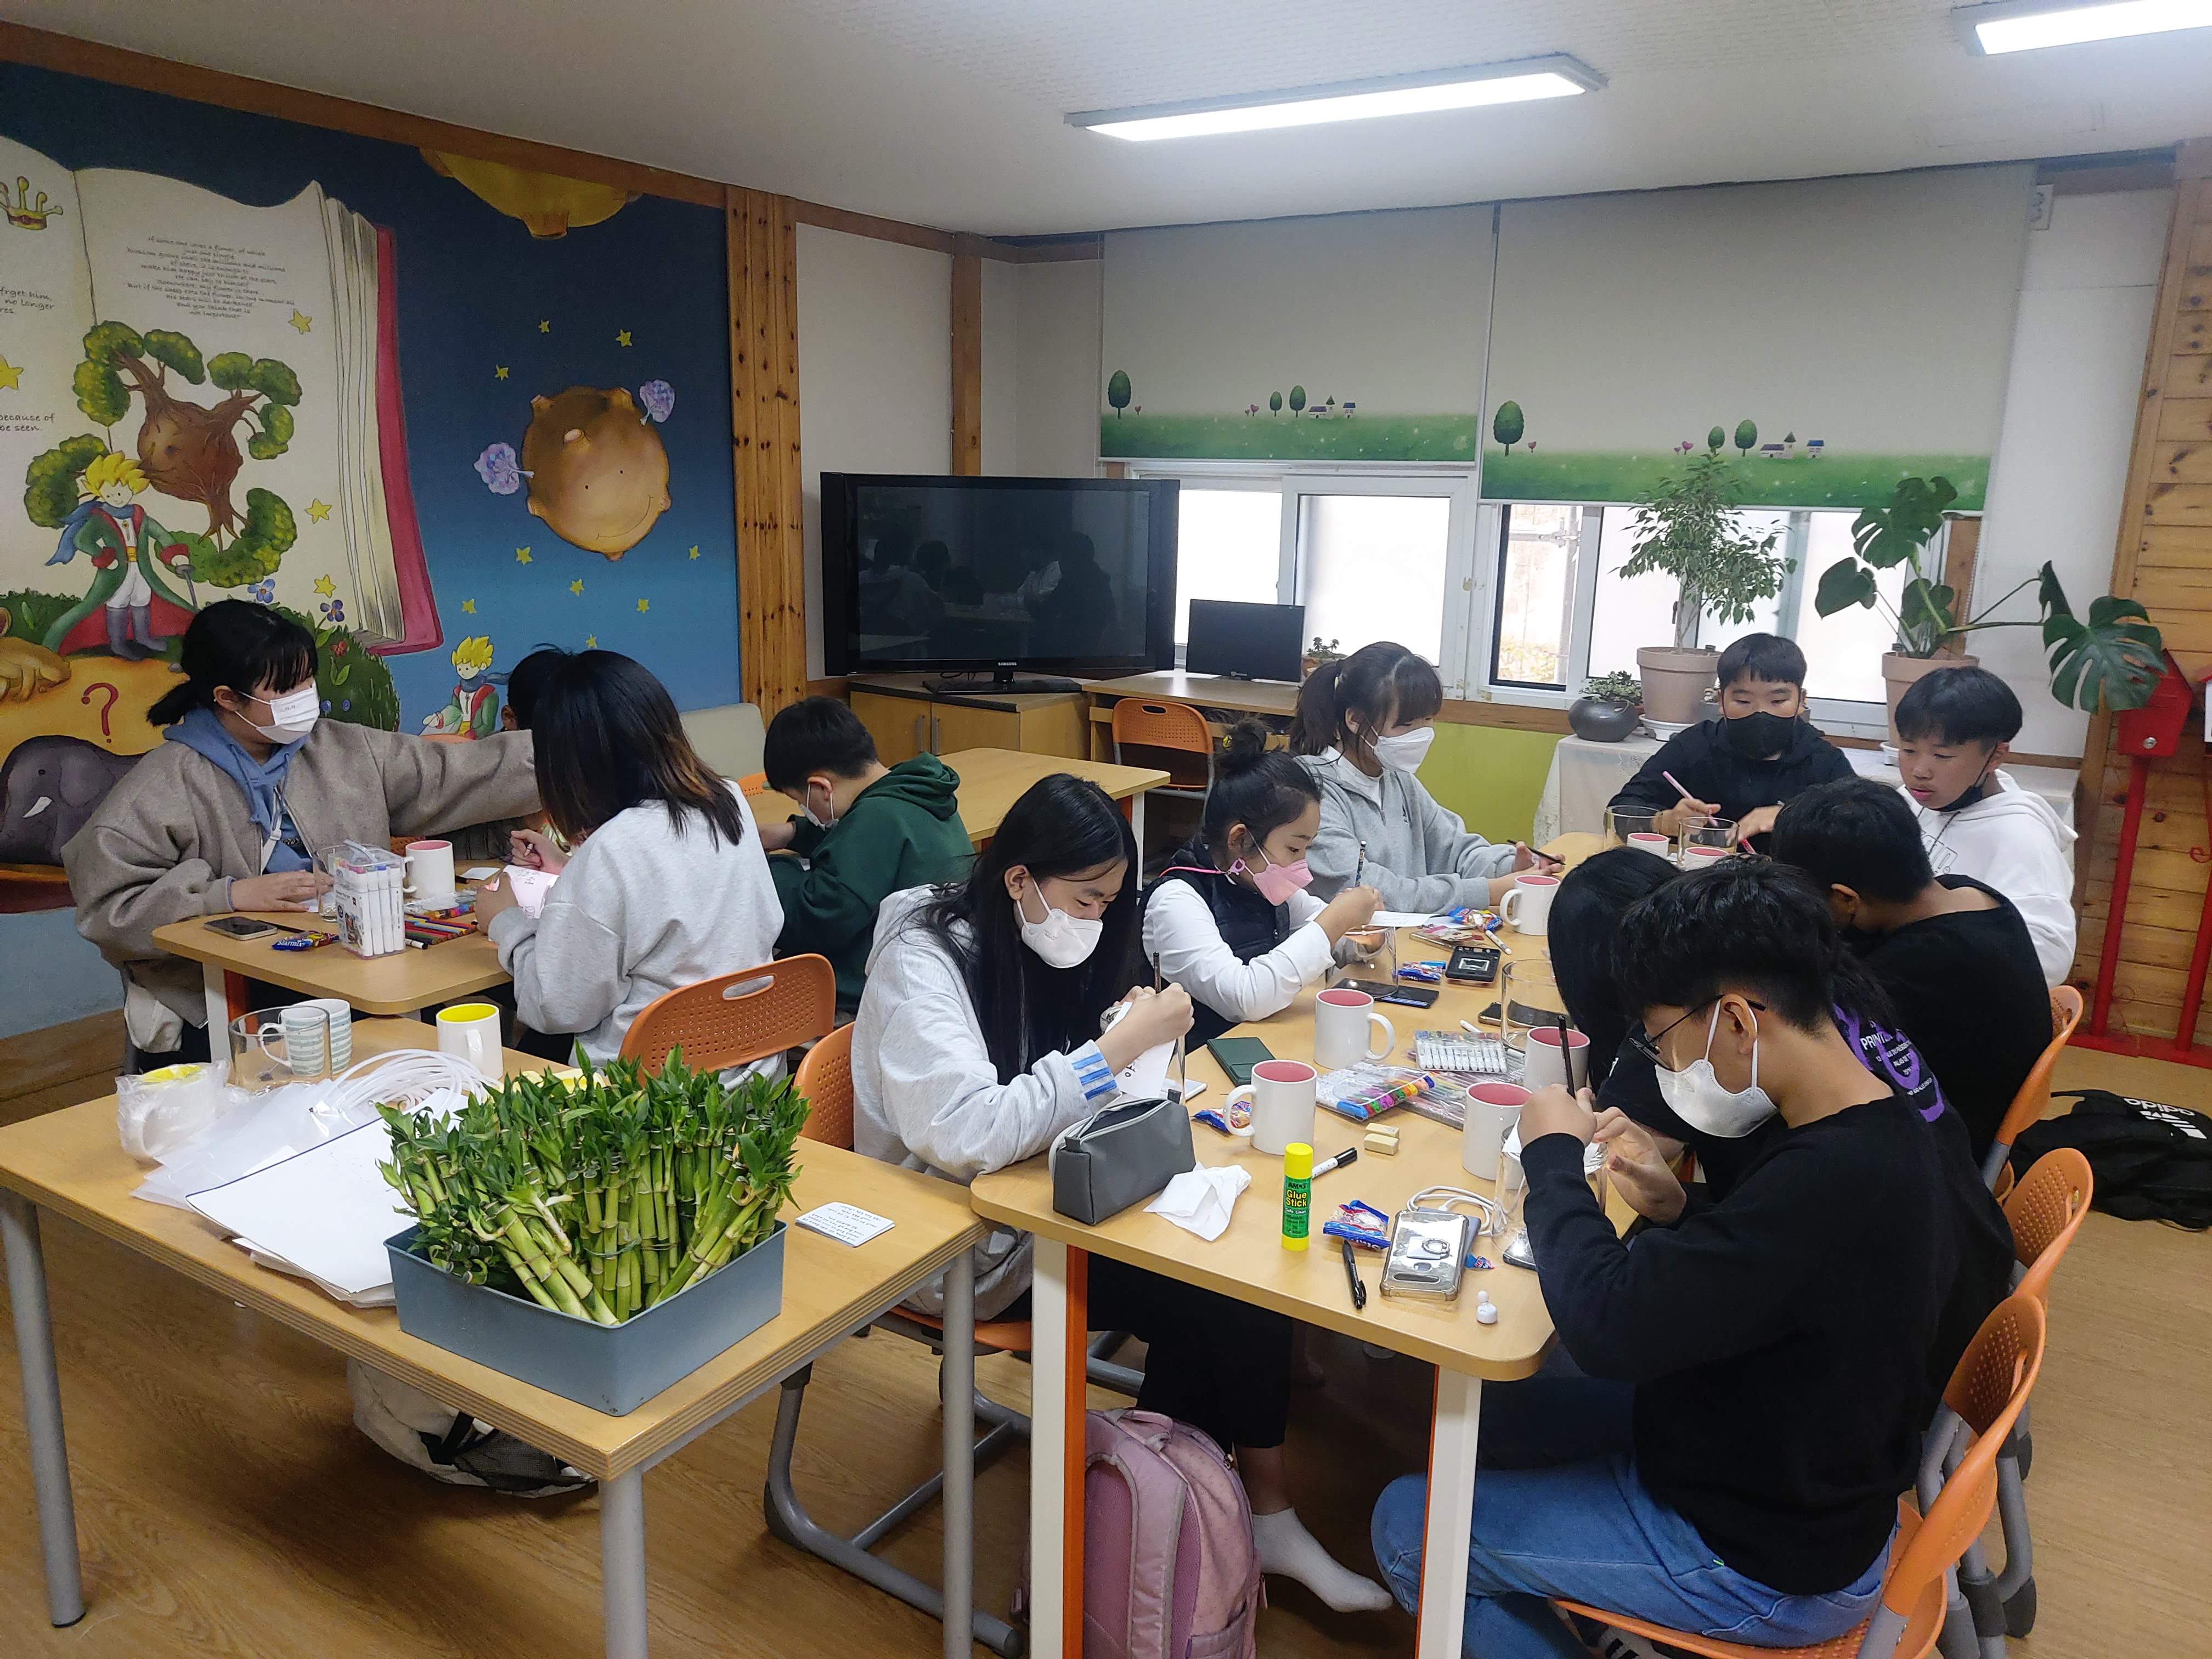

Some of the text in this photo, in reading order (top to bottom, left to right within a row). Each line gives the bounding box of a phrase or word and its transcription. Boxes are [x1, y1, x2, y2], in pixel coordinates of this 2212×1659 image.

[44, 413, 55, 424] of
[2123, 1098, 2196, 1116] adida
[1286, 1189, 1307, 1199] Glue
[1285, 1197, 1307, 1207] Stick
